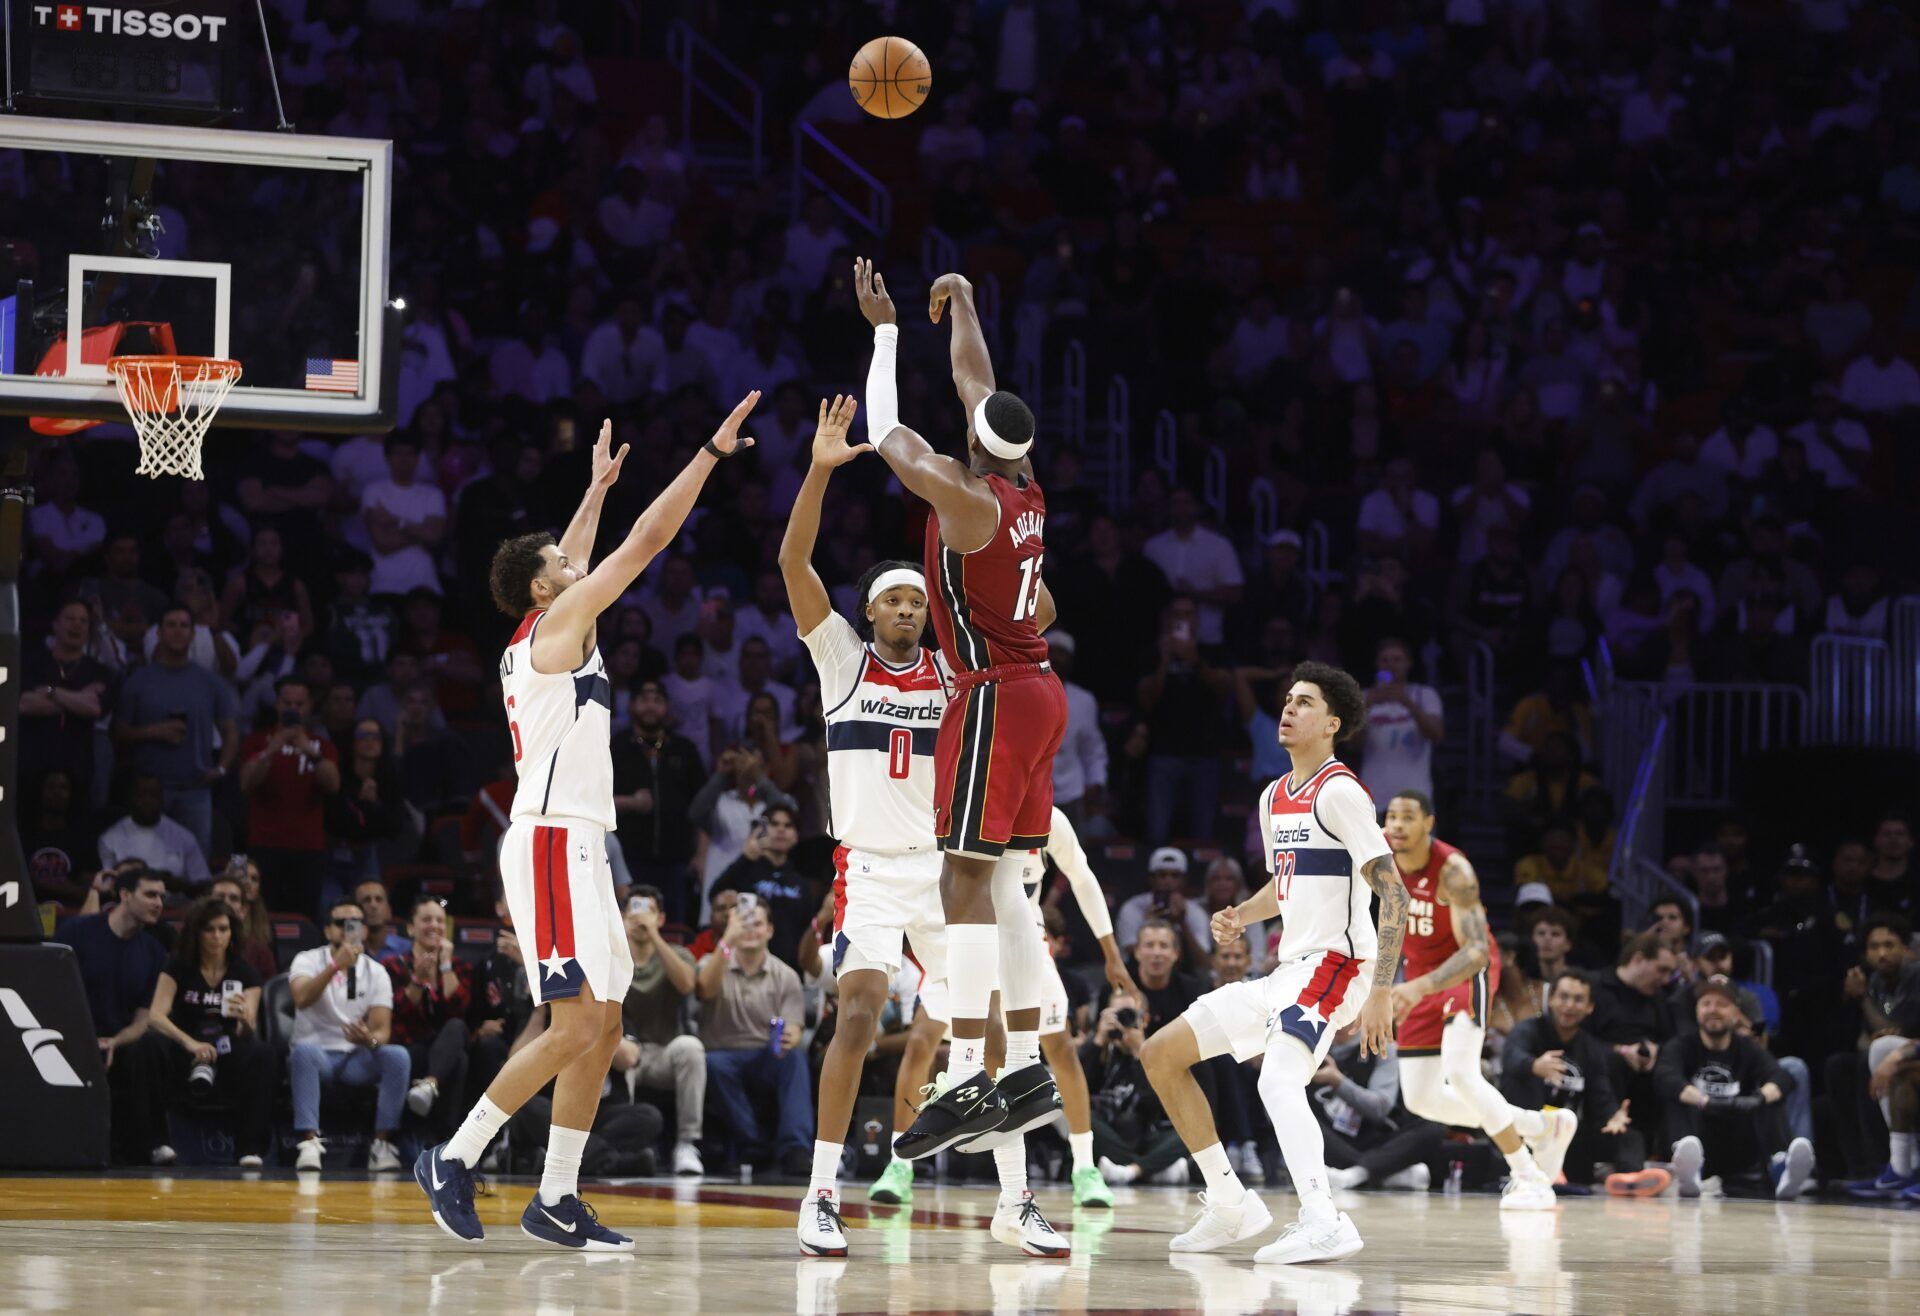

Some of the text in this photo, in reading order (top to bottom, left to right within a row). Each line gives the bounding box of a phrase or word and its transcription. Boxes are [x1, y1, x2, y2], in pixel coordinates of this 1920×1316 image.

[86, 7, 227, 42] TISSOT
[861, 696, 942, 720] wizards
[889, 728, 912, 780] 0
[1408, 916, 1434, 937] 16
